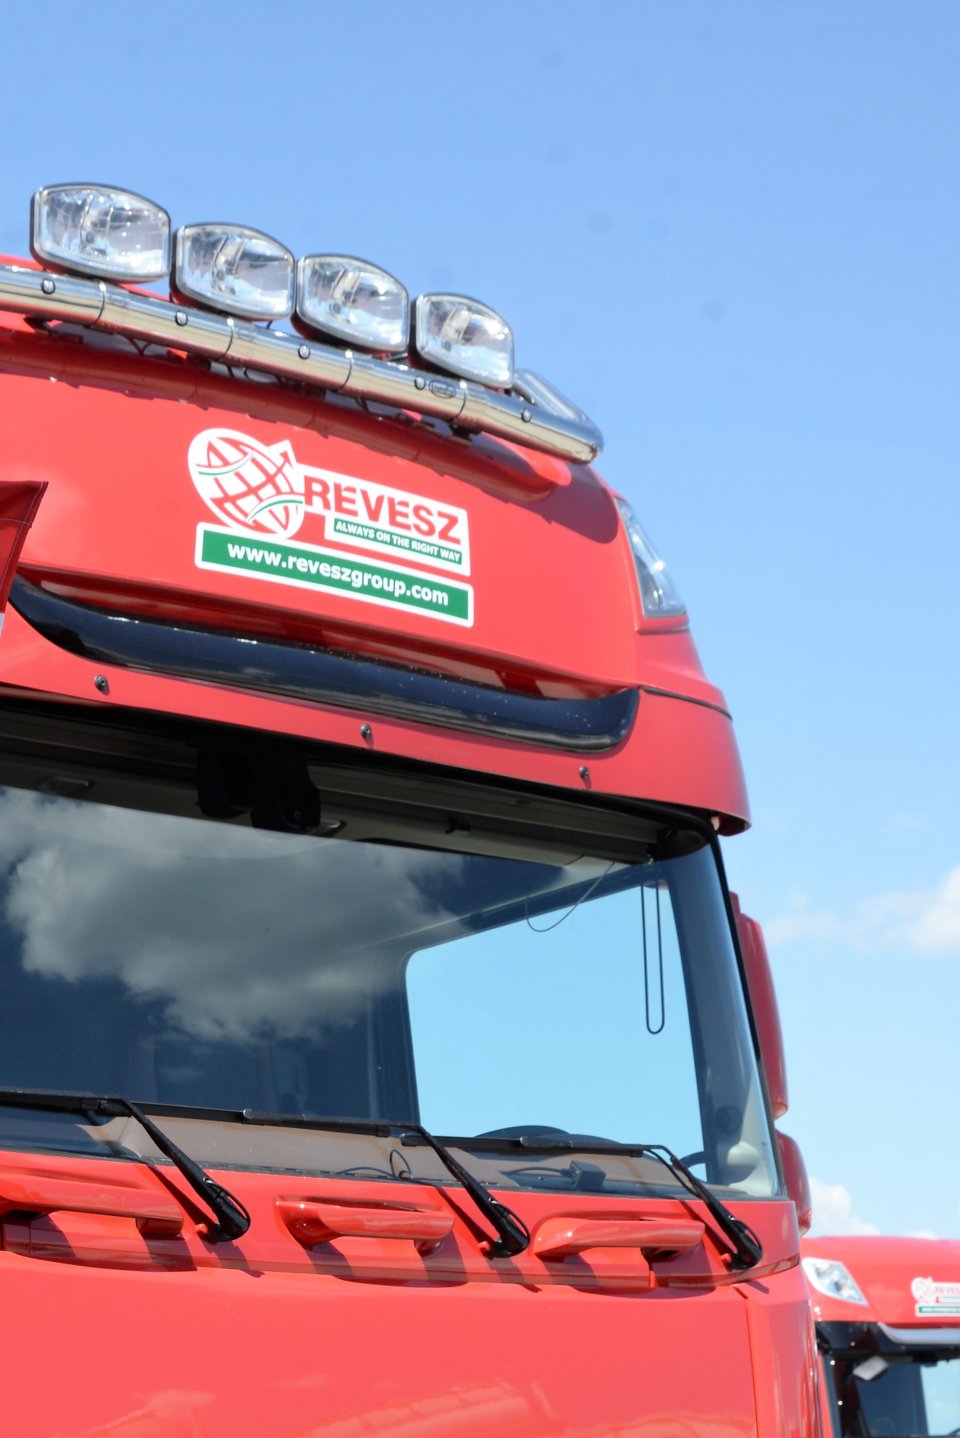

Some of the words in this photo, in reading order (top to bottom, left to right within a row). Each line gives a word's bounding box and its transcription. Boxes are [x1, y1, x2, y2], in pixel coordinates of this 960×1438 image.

[304, 475, 461, 545] REVESZ
[335, 521, 375, 539] ALWAYS
[376, 532, 391, 543] ON
[392, 535, 410, 548] THE
[411, 540, 439, 556] RIGHT
[440, 548, 461, 562] WAY
[227, 543, 449, 606] www.reveszgroup.com
